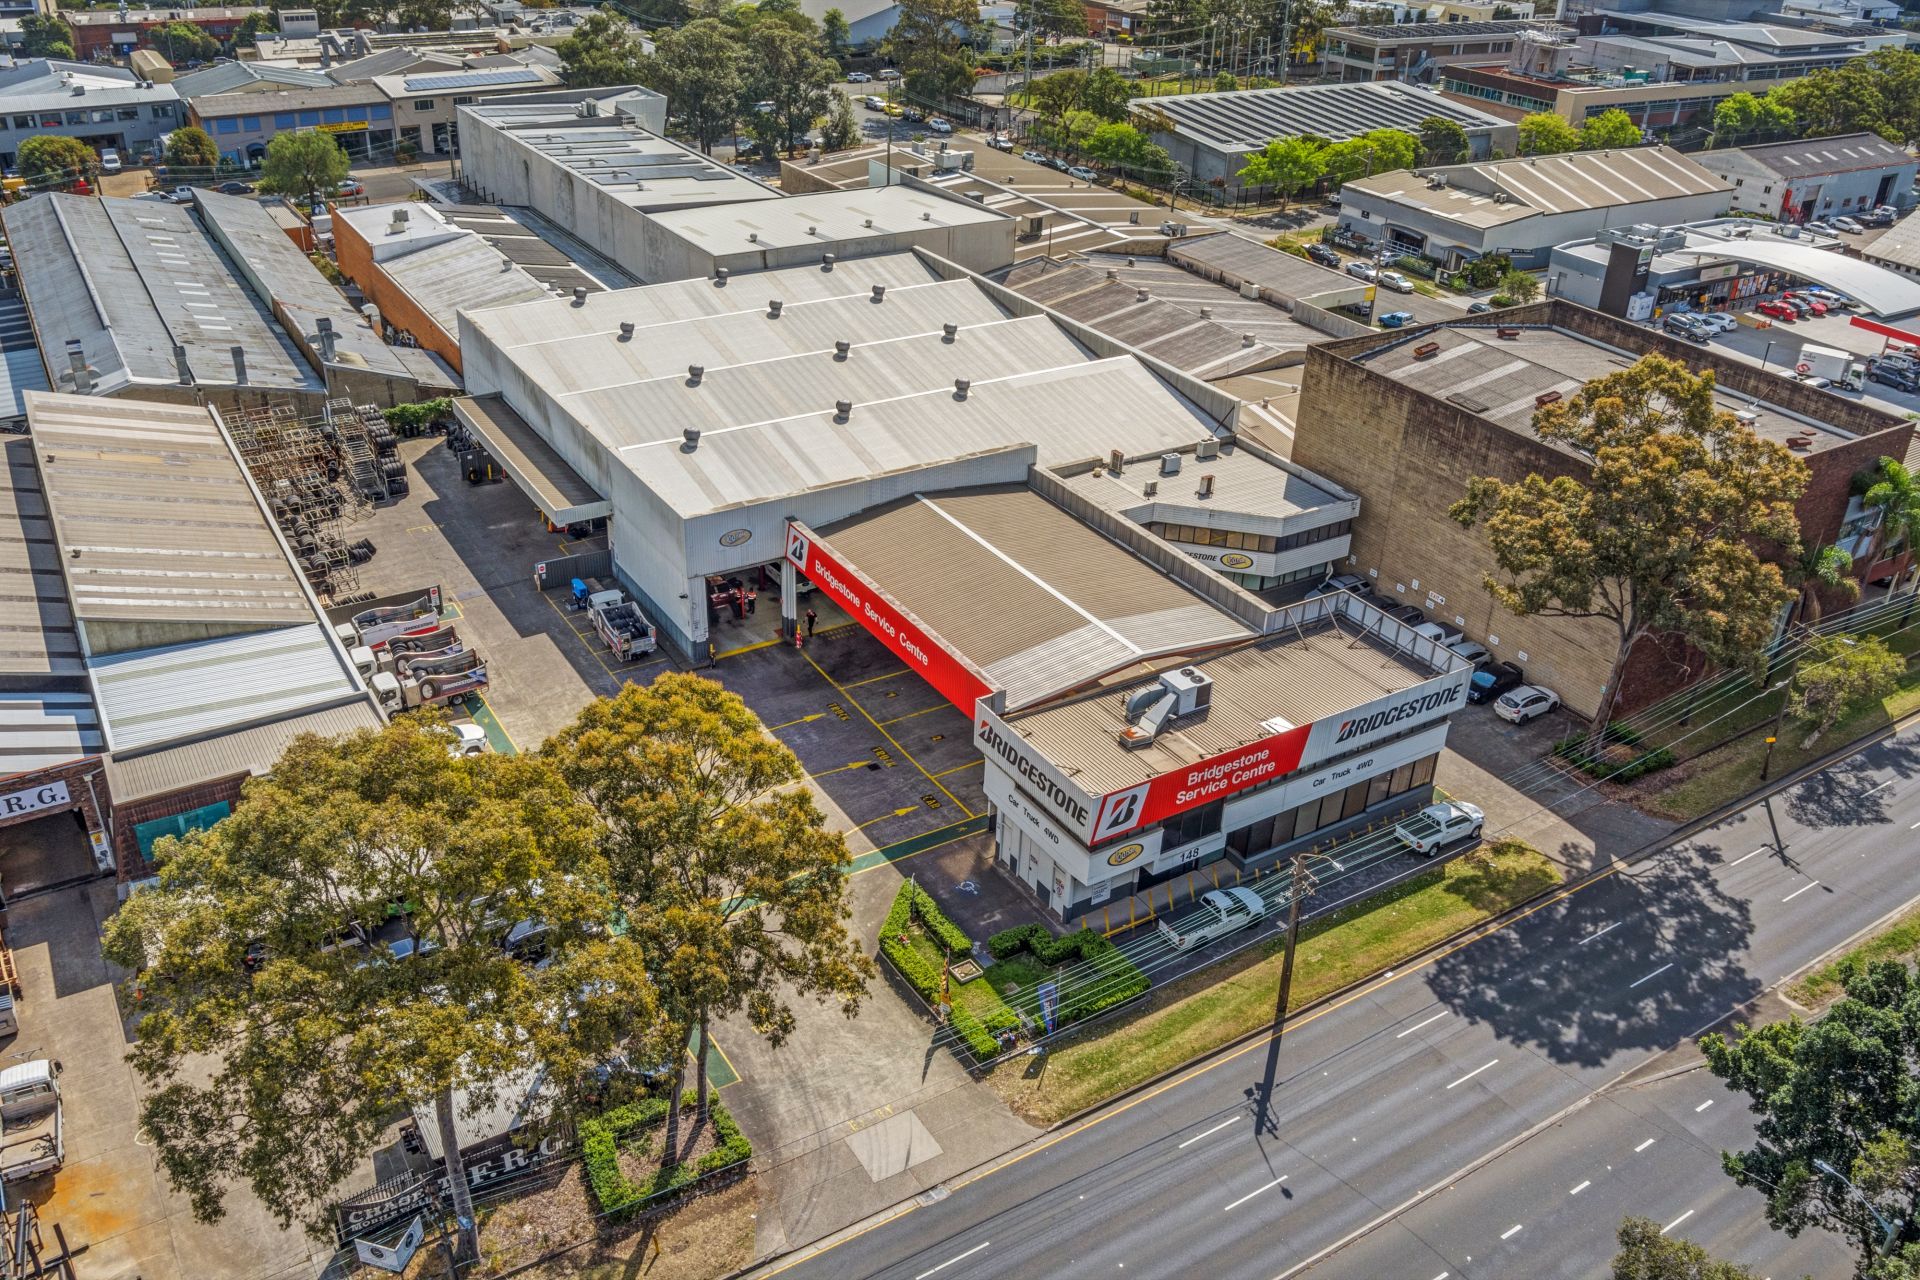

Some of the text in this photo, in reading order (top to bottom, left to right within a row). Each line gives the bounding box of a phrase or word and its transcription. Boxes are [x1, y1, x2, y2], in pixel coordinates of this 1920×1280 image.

[815, 559, 861, 608] Bridgestone
[864, 602, 896, 637] Service
[899, 632, 929, 666] Centre
[1335, 683, 1464, 744] BRIDGESTONE
[978, 719, 1089, 827] BRIDGESTONE
[1176, 761, 1276, 805] Service Centre
[1187, 749, 1270, 786] Bridgestone
[1313, 758, 1374, 788] Car Truck 4WD
[1008, 794, 1060, 845] Car Truck 4WD
[1180, 847, 1200, 863] 148
